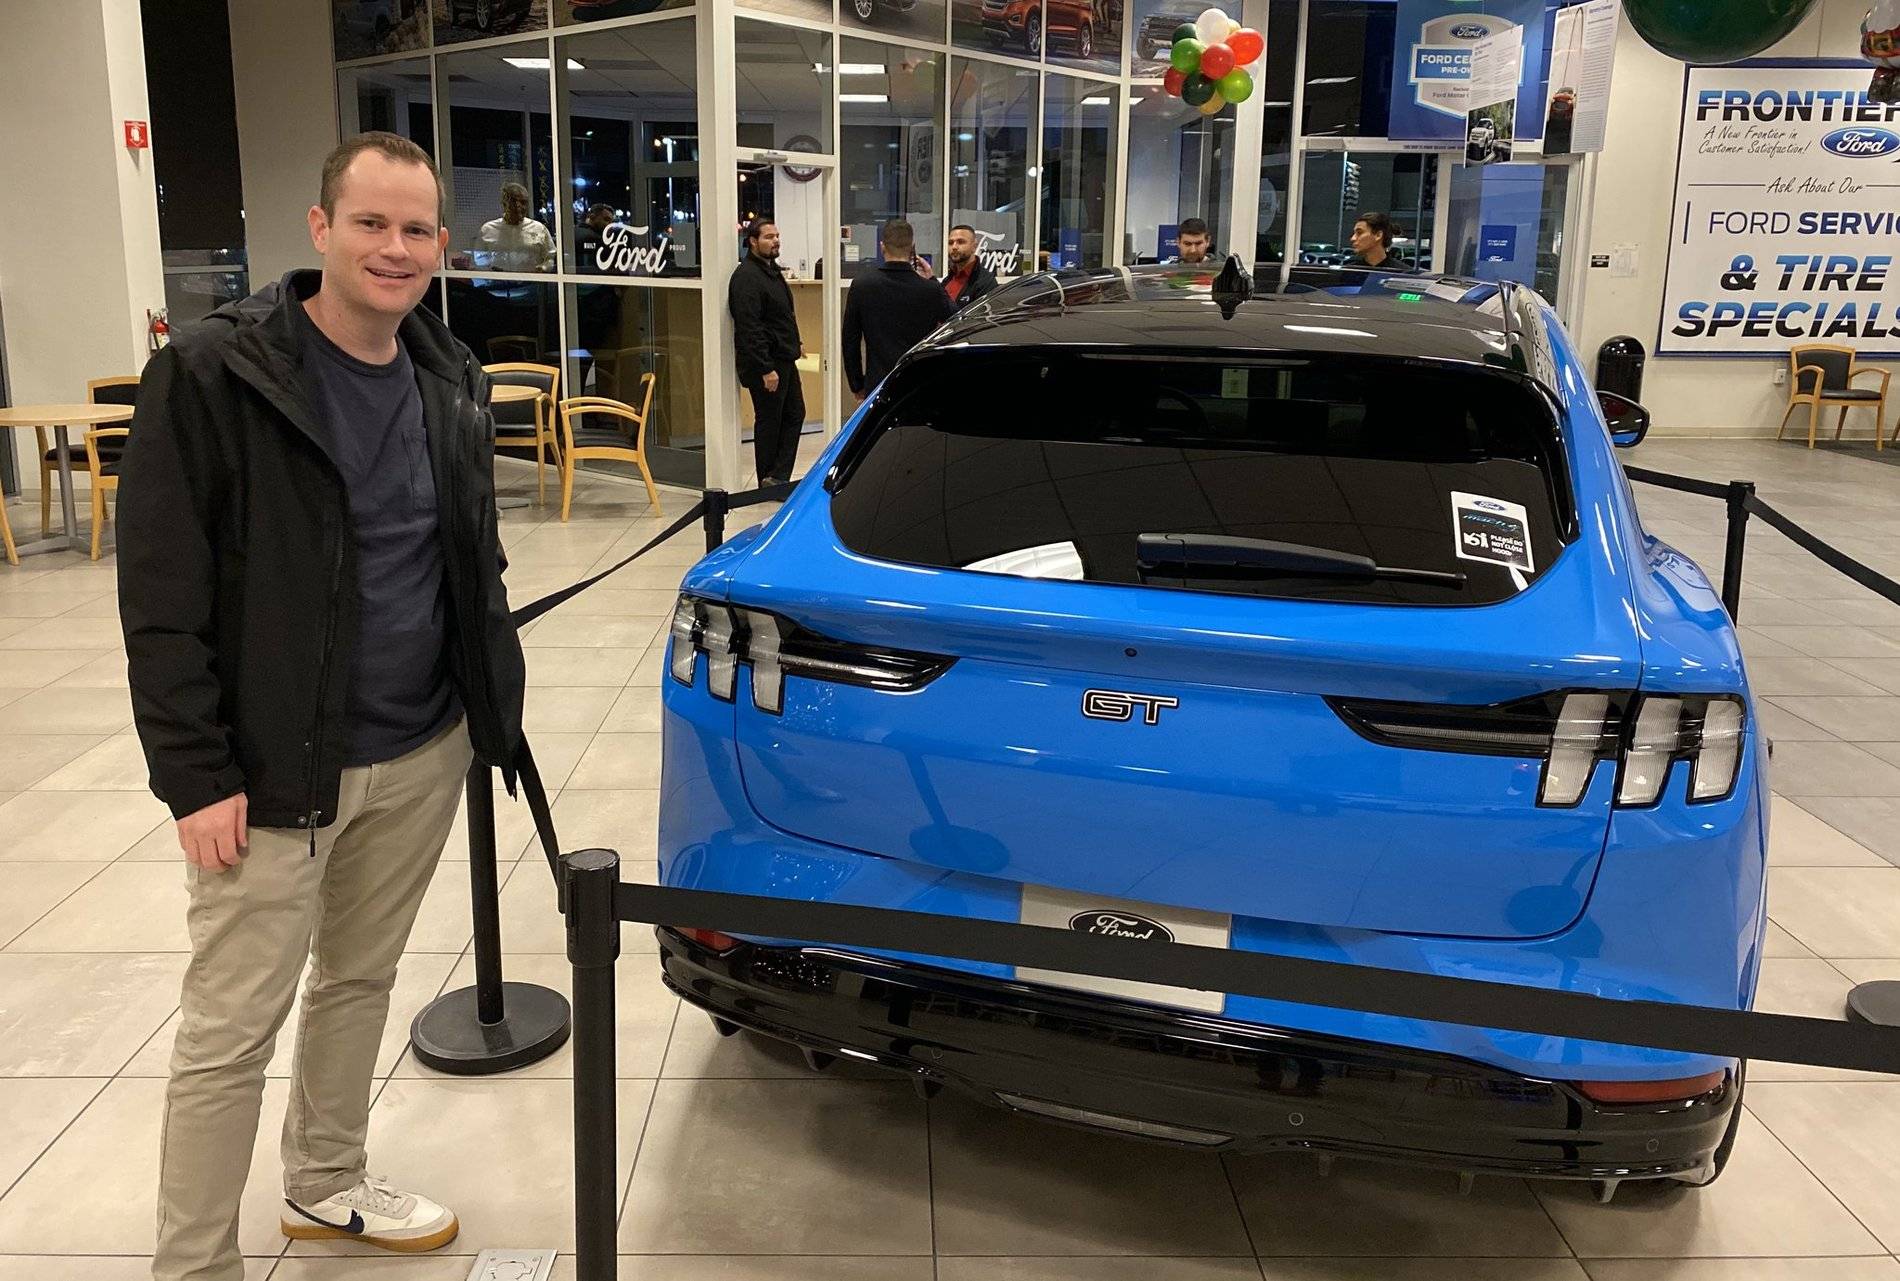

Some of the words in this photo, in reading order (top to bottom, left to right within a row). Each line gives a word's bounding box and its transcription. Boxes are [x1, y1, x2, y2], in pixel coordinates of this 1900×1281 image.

[1457, 25, 1485, 38] Ford
[1421, 54, 1452, 64] FORD
[1454, 55, 1472, 64] CE
[1704, 125, 1717, 139] A
[1718, 125, 1741, 139] New
[1745, 125, 1785, 140] Frontier
[1789, 128, 1798, 139] in
[1836, 131, 1888, 153] Ford
[1698, 140, 1743, 155] Customer
[1747, 140, 1812, 158] Satisfaction!
[1767, 176, 1794, 194] Ask
[1798, 176, 1834, 194] About
[1838, 176, 1863, 194] Our
[1709, 211, 1791, 235] FORD
[596, 222, 668, 274] Ford
[1720, 254, 1759, 291] &
[1775, 255, 1893, 291] TIRE
[1082, 688, 1179, 725] GT
